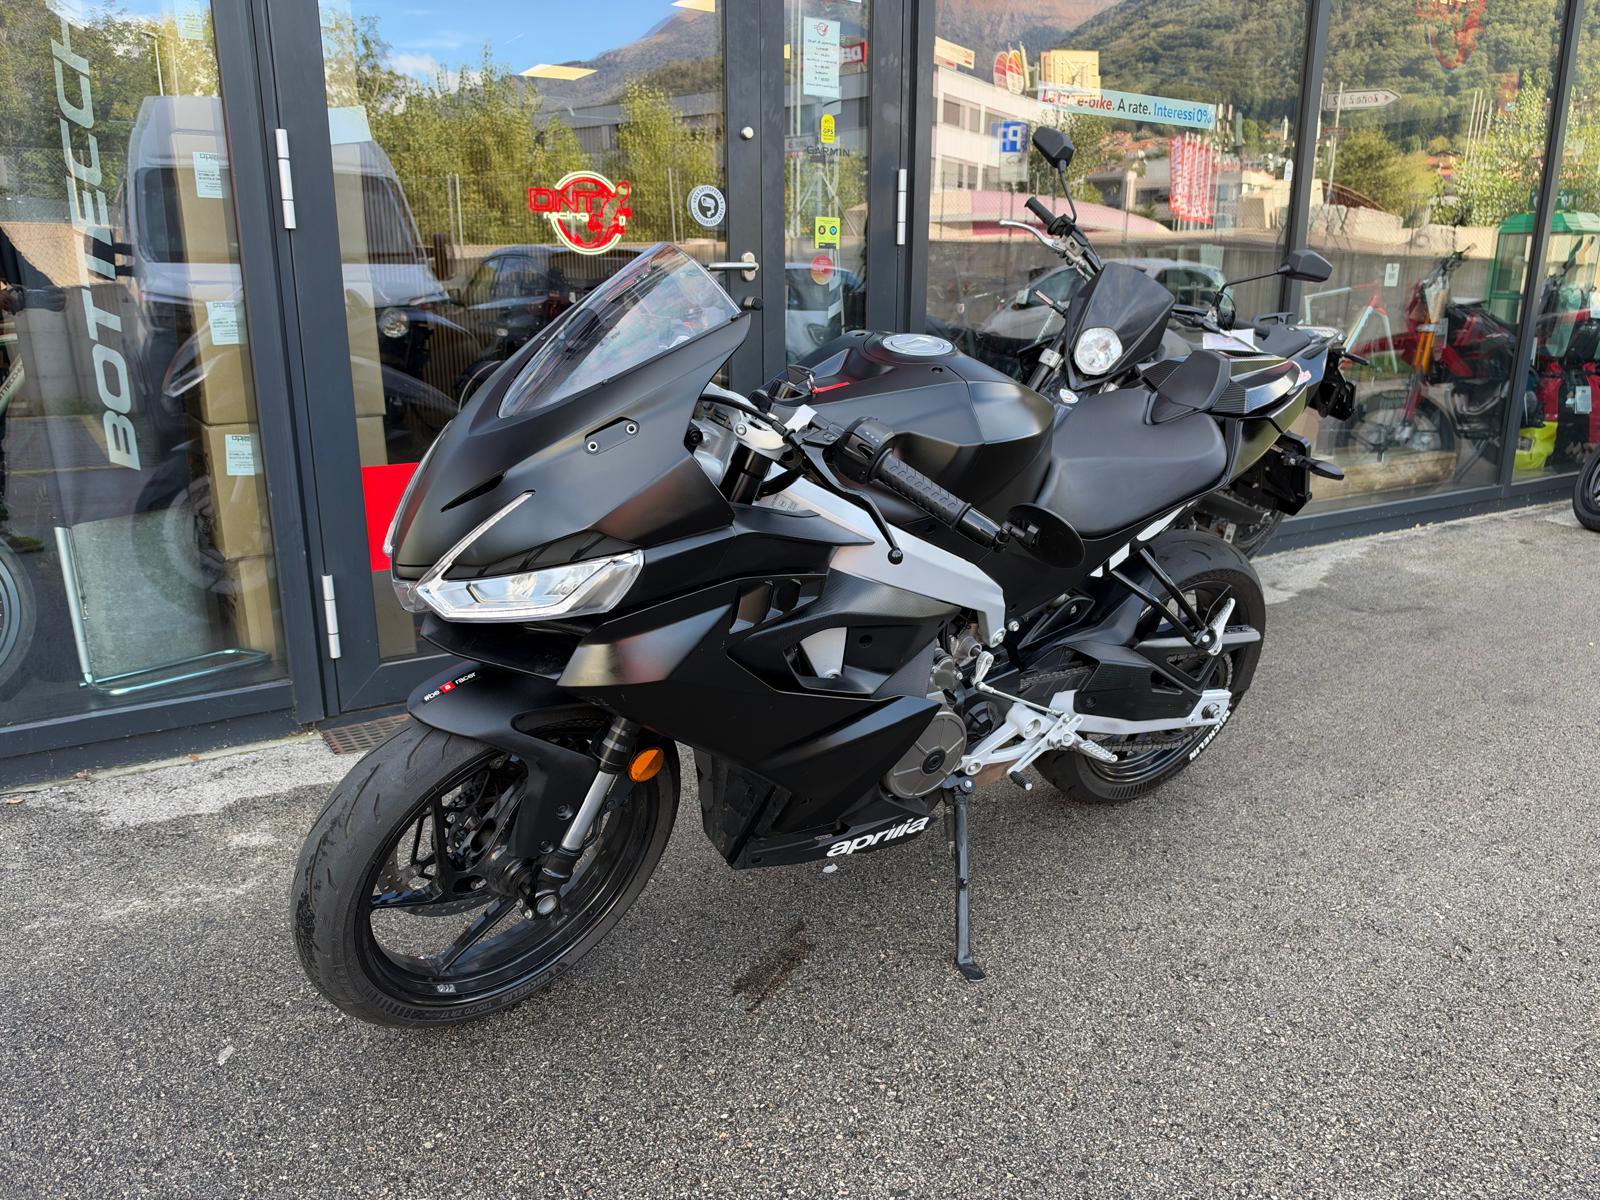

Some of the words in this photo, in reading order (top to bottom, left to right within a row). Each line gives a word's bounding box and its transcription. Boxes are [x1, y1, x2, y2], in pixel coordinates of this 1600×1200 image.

[1117, 98, 1126, 112] A
[1128, 101, 1151, 116] rate.
[1153, 102, 1195, 121] Interessi
[1196, 109, 1212, 124] 0%
[806, 146, 850, 158] GARMIN
[424, 690, 440, 702] #be
[455, 672, 476, 684] racer
[1189, 709, 1230, 760] MICHELIN
[826, 816, 930, 857] aprilia
